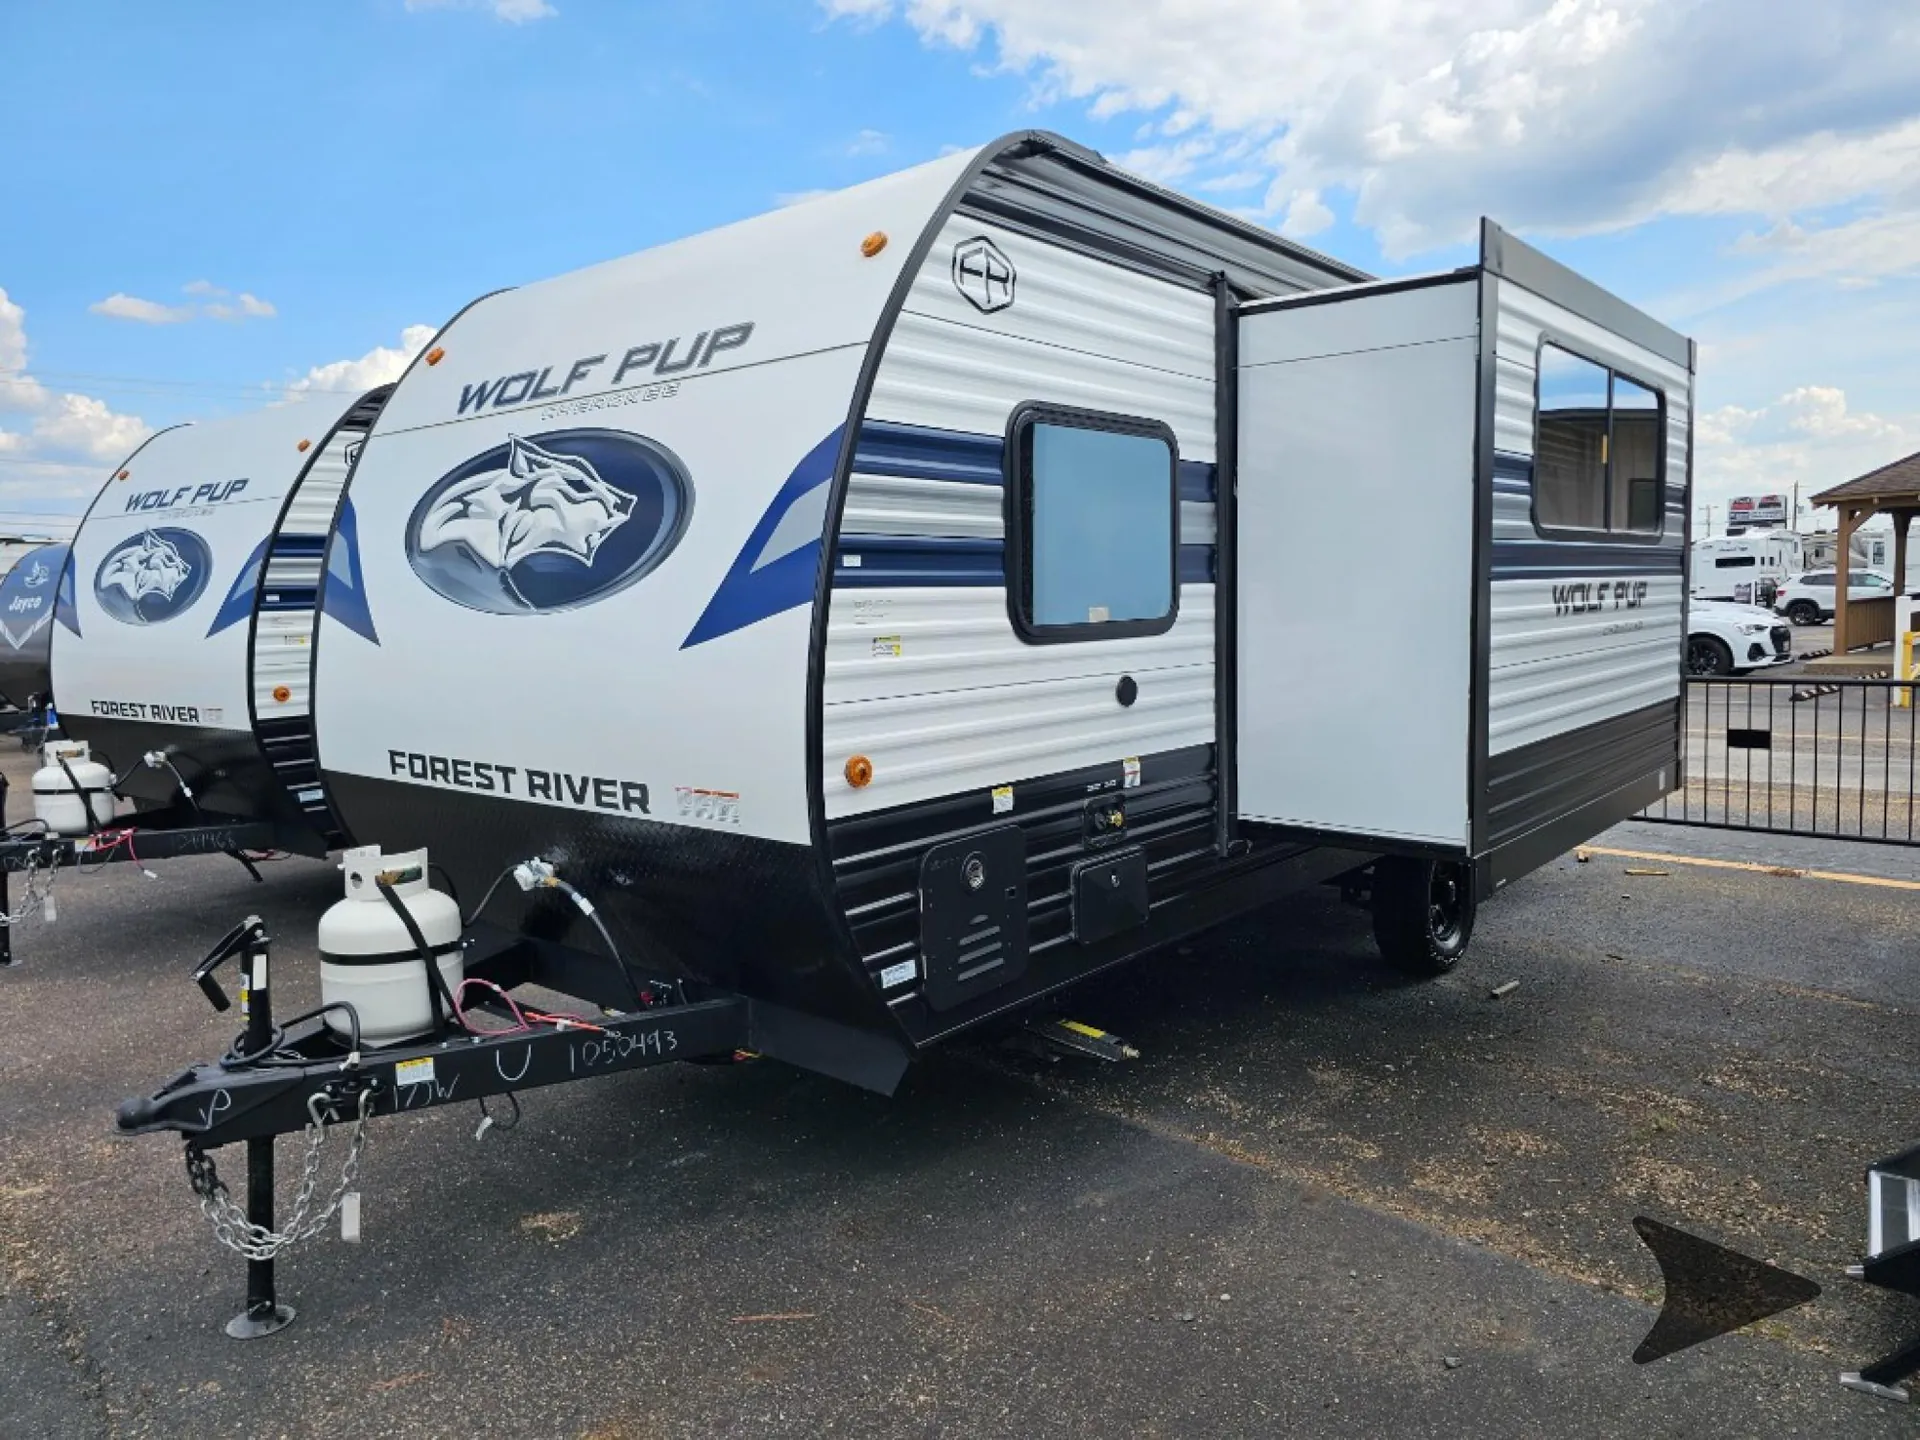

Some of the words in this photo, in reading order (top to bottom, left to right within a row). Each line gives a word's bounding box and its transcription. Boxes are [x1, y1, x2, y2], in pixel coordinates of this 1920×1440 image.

[457, 353, 608, 415] WOLF
[611, 321, 756, 384] PUP
[125, 486, 193, 512] WOLF
[189, 478, 250, 504] PUP
[9, 595, 42, 613] Jayco
[1552, 583, 1610, 616] WOLF
[1614, 581, 1648, 610] PUP
[90, 699, 147, 719] FOREST
[149, 704, 200, 722] RIVER
[388, 749, 517, 794] FOREST
[525, 768, 651, 815] RIVER
[569, 1029, 678, 1074] 1050493
